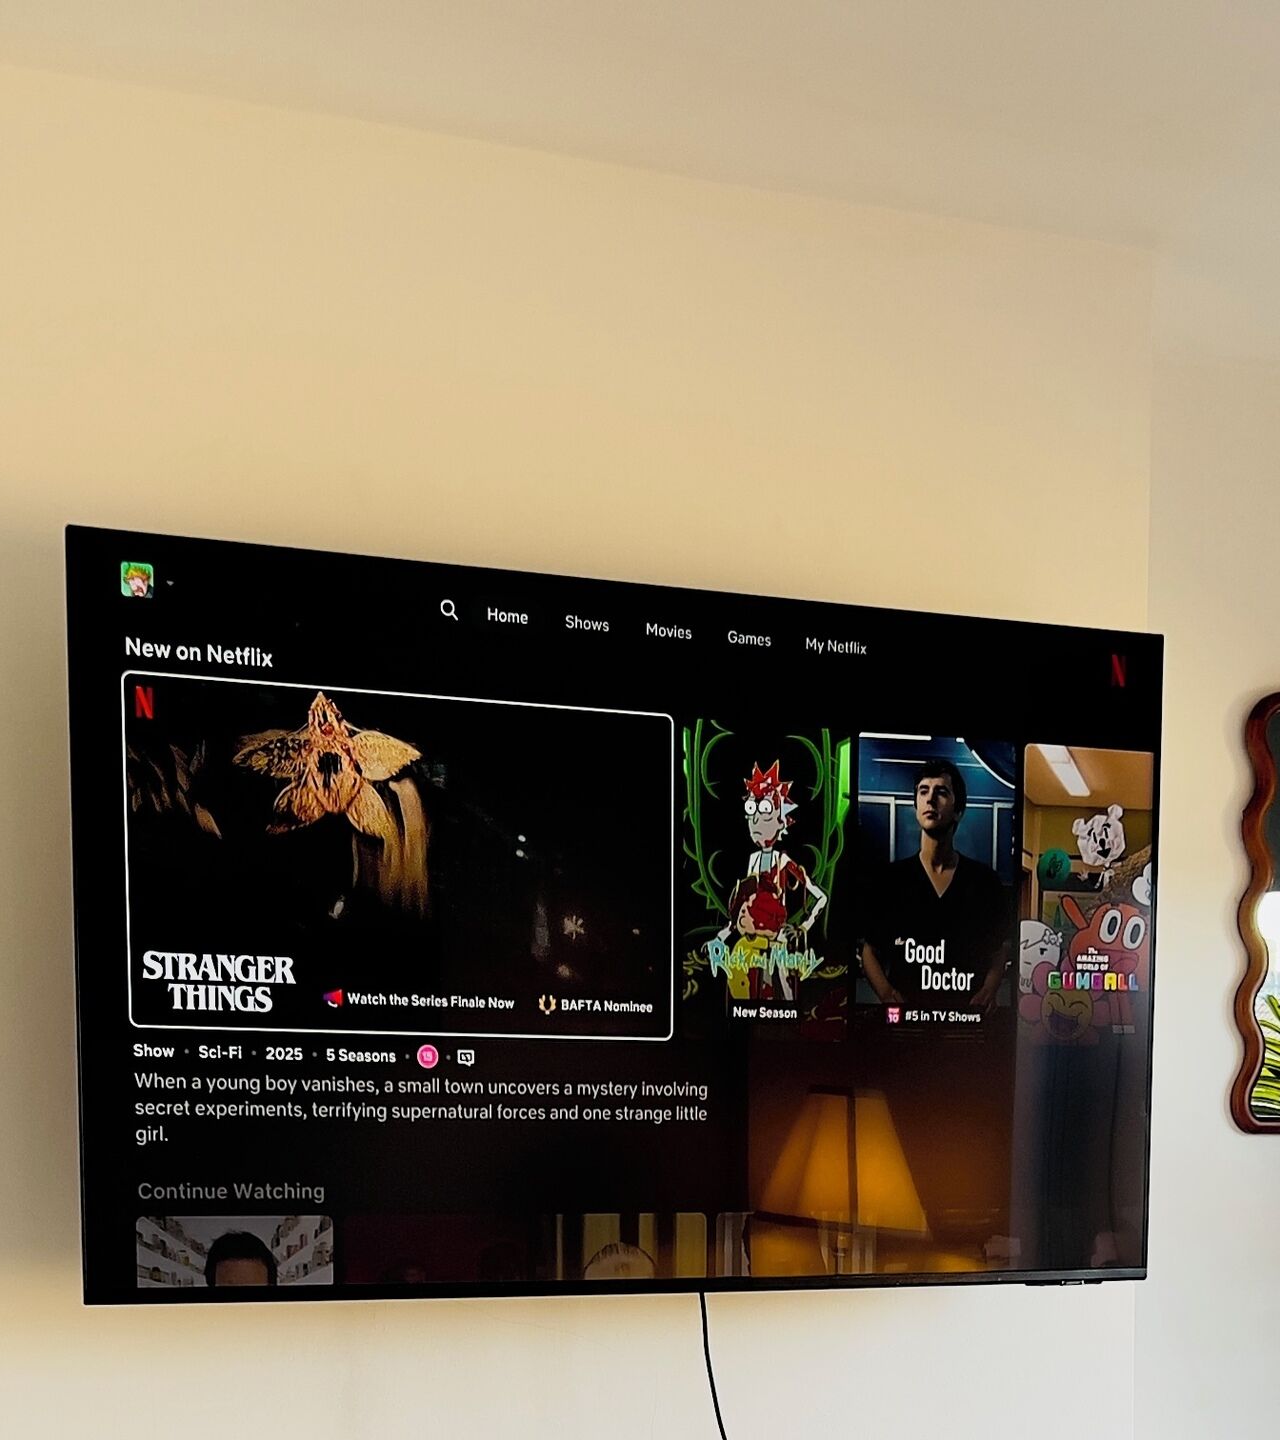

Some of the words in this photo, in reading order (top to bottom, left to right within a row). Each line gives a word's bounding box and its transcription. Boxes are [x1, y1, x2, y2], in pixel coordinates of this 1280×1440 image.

[487, 606, 529, 625] Home
[565, 614, 610, 633] Shows
[646, 622, 693, 640] Movies
[727, 630, 772, 647] Games
[125, 636, 172, 659] New
[175, 645, 202, 662] on
[206, 643, 273, 668] Netflix
[805, 636, 825, 655] My
[827, 639, 867, 655] Netflix
[135, 685, 154, 720] N
[905, 937, 945, 964] Good
[142, 950, 297, 985] STRANGER
[921, 964, 975, 991] Doctor
[1047, 971, 1139, 991] GUMBALL
[167, 983, 274, 1013] THINGS
[347, 991, 387, 1006] Watch
[388, 993, 409, 1007] the
[410, 993, 449, 1008] Series
[450, 995, 486, 1009] Finale
[488, 996, 515, 1010] Now
[560, 998, 602, 1012] BAFTA
[603, 999, 653, 1013] Nominee
[732, 1005, 757, 1018] New
[759, 1006, 798, 1019] Season
[920, 1010, 930, 1022] in
[931, 1010, 947, 1022] TV
[948, 1010, 982, 1023] Shows
[132, 1043, 175, 1058] Show
[198, 1044, 243, 1060] Sci-Fi
[265, 1046, 304, 1061] 2025
[326, 1047, 336, 1062] 5
[338, 1048, 397, 1063] Seasons
[133, 1072, 187, 1090] When
[191, 1076, 202, 1090] a
[205, 1077, 261, 1095] young
[265, 1074, 298, 1095] boy
[301, 1075, 380, 1096] vanishes,
[384, 1080, 394, 1093] a
[397, 1077, 440, 1094] small
[444, 1078, 484, 1094] town
[488, 1082, 560, 1096] uncovers
[563, 1083, 573, 1096] a
[577, 1080, 638, 1100] mystery
[641, 1080, 708, 1101] involving
[134, 1100, 191, 1116] secret
[194, 1100, 308, 1121] experiments,
[311, 1101, 387, 1123] terrifying
[391, 1103, 493, 1123] supernatural
[496, 1103, 546, 1120] forces
[549, 1104, 579, 1120] and
[582, 1108, 612, 1121] one
[615, 1105, 672, 1125] strange
[676, 1105, 708, 1121] little
[135, 1125, 169, 1146] girl.
[138, 1182, 228, 1200] Continue
[233, 1182, 325, 1204] Watching
